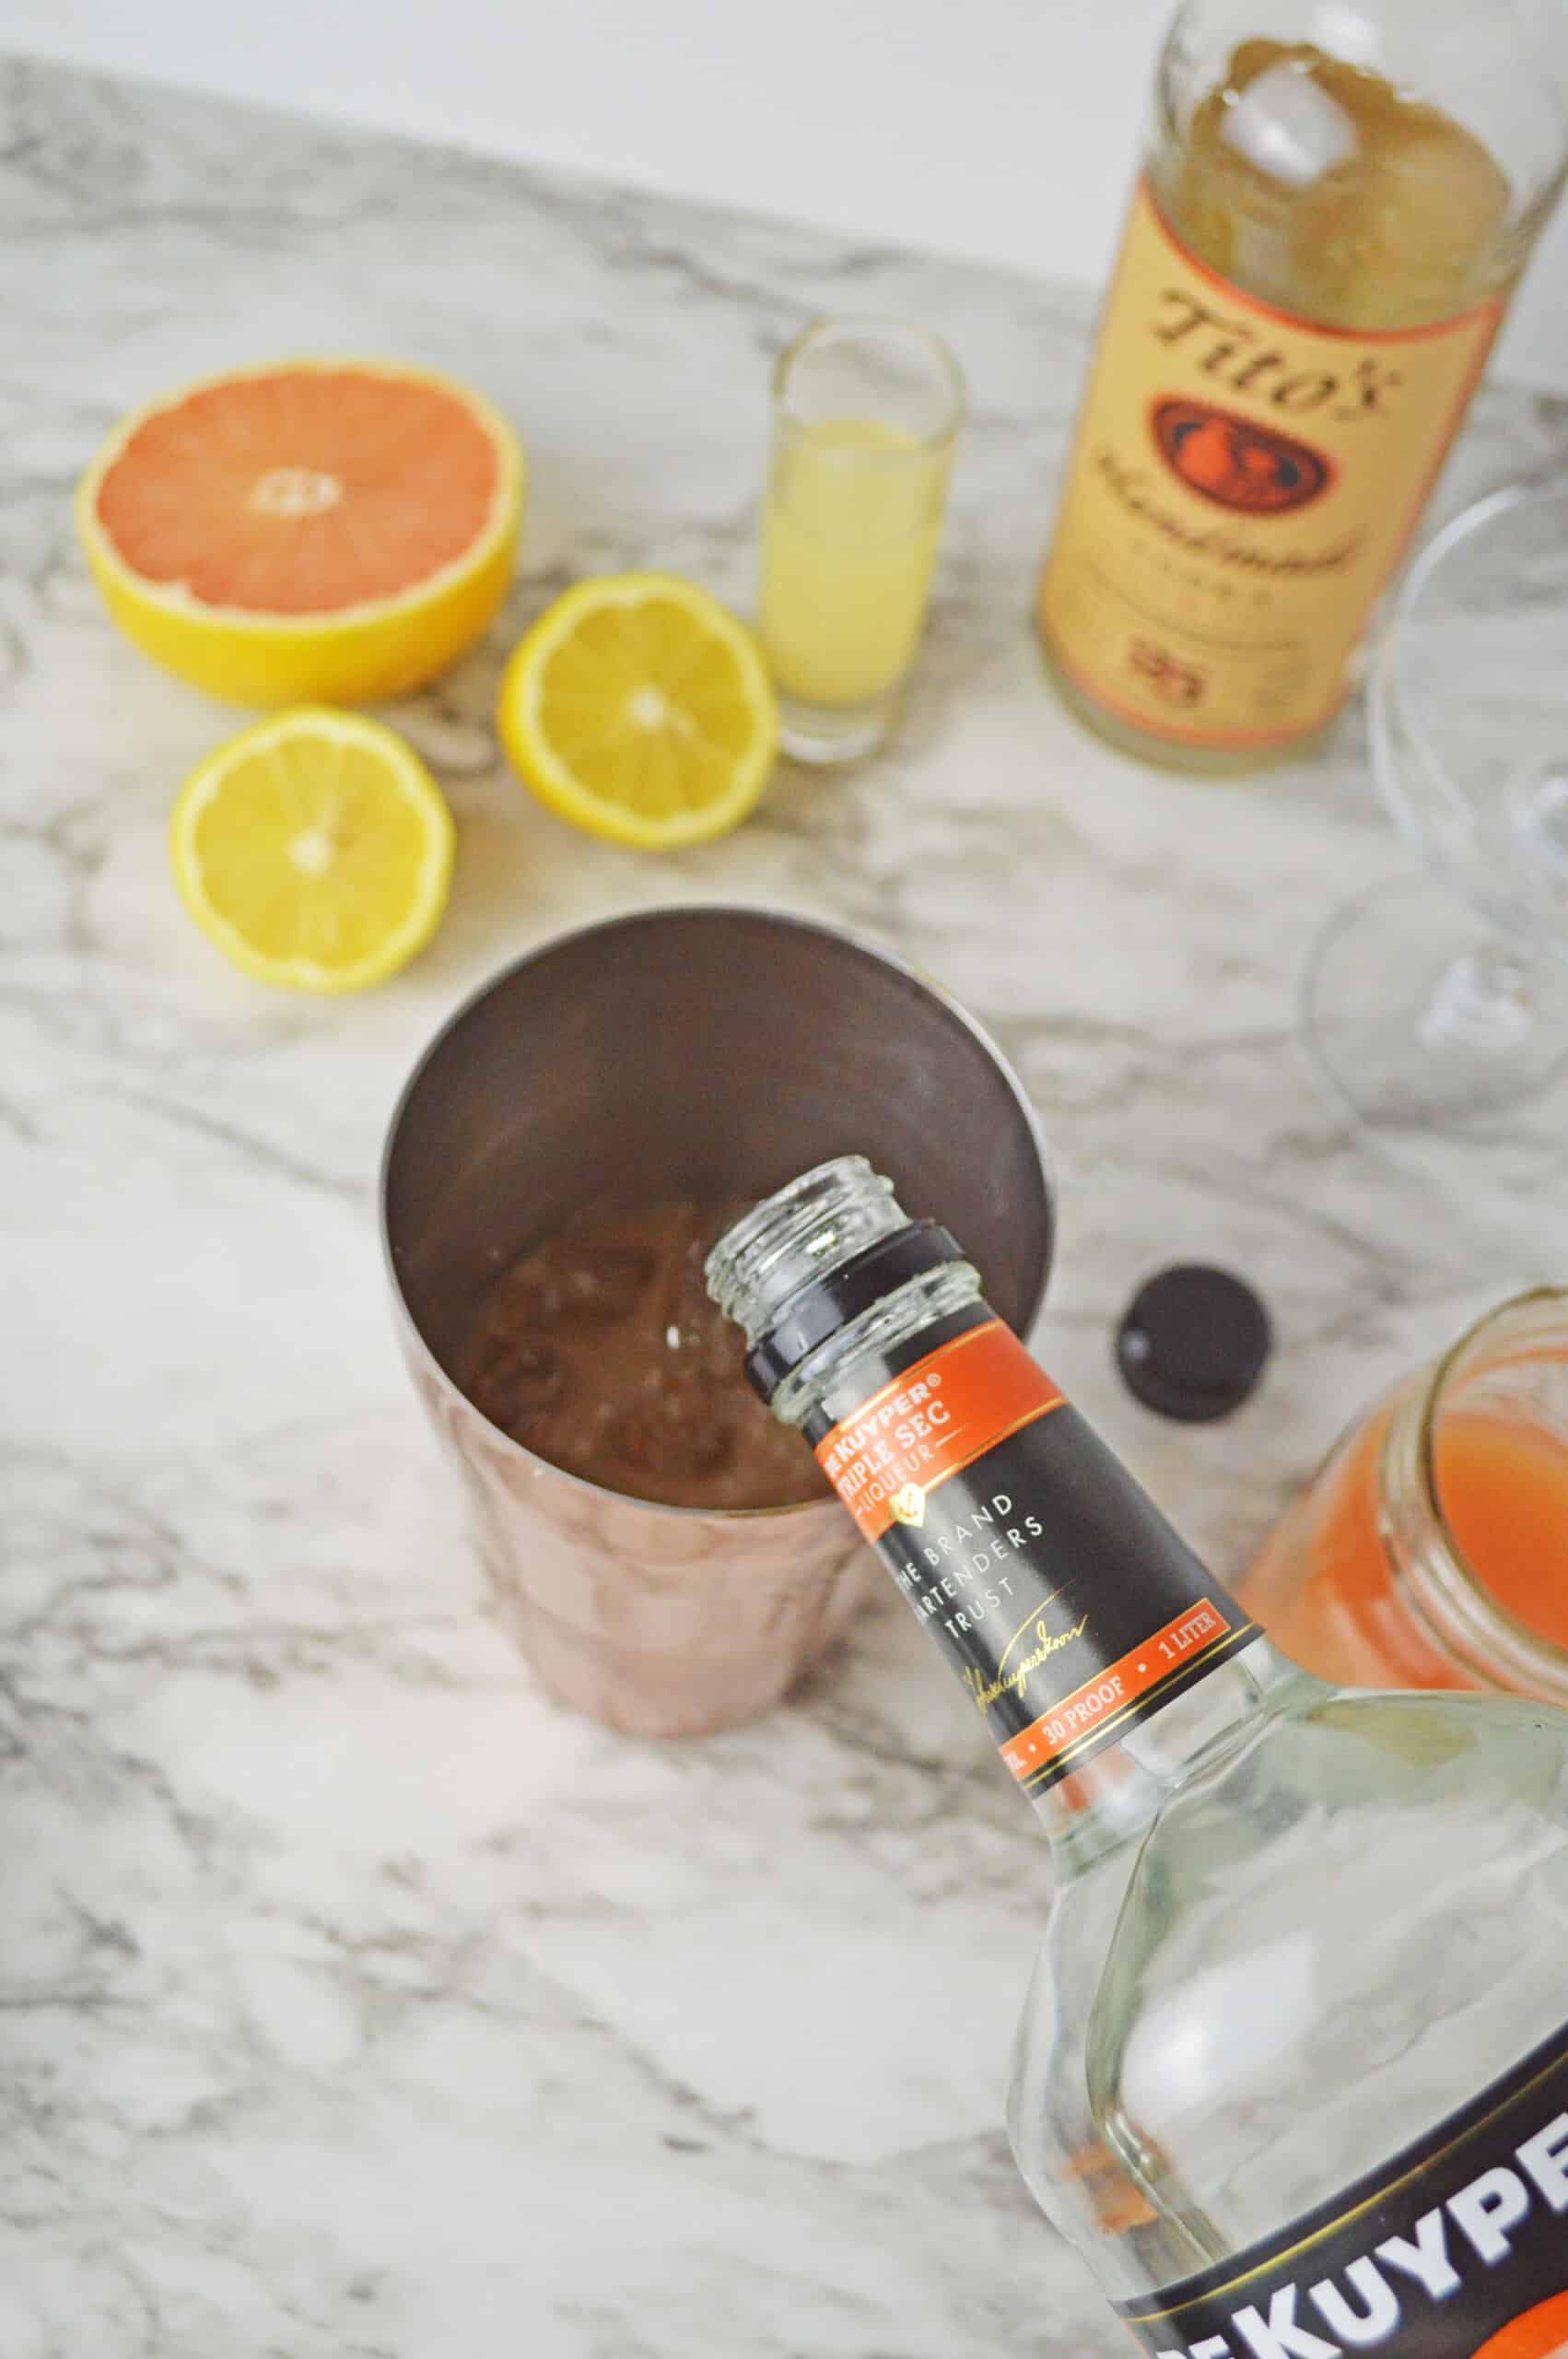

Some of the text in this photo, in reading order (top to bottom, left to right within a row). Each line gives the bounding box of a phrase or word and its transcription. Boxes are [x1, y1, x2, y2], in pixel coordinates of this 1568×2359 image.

[1152, 288, 1403, 422] Tito's
[895, 1400, 951, 1448] SEC
[897, 1494, 1012, 1593] HE BRAND
[913, 1516, 1043, 1622] ARTENDERS
[944, 1577, 1013, 1638] TRUST
[1041, 1719, 1066, 1745] 30
[1064, 1675, 1126, 1731] PROOF
[1158, 1640, 1176, 1660] 1
[1171, 1611, 1217, 1649] LITER
